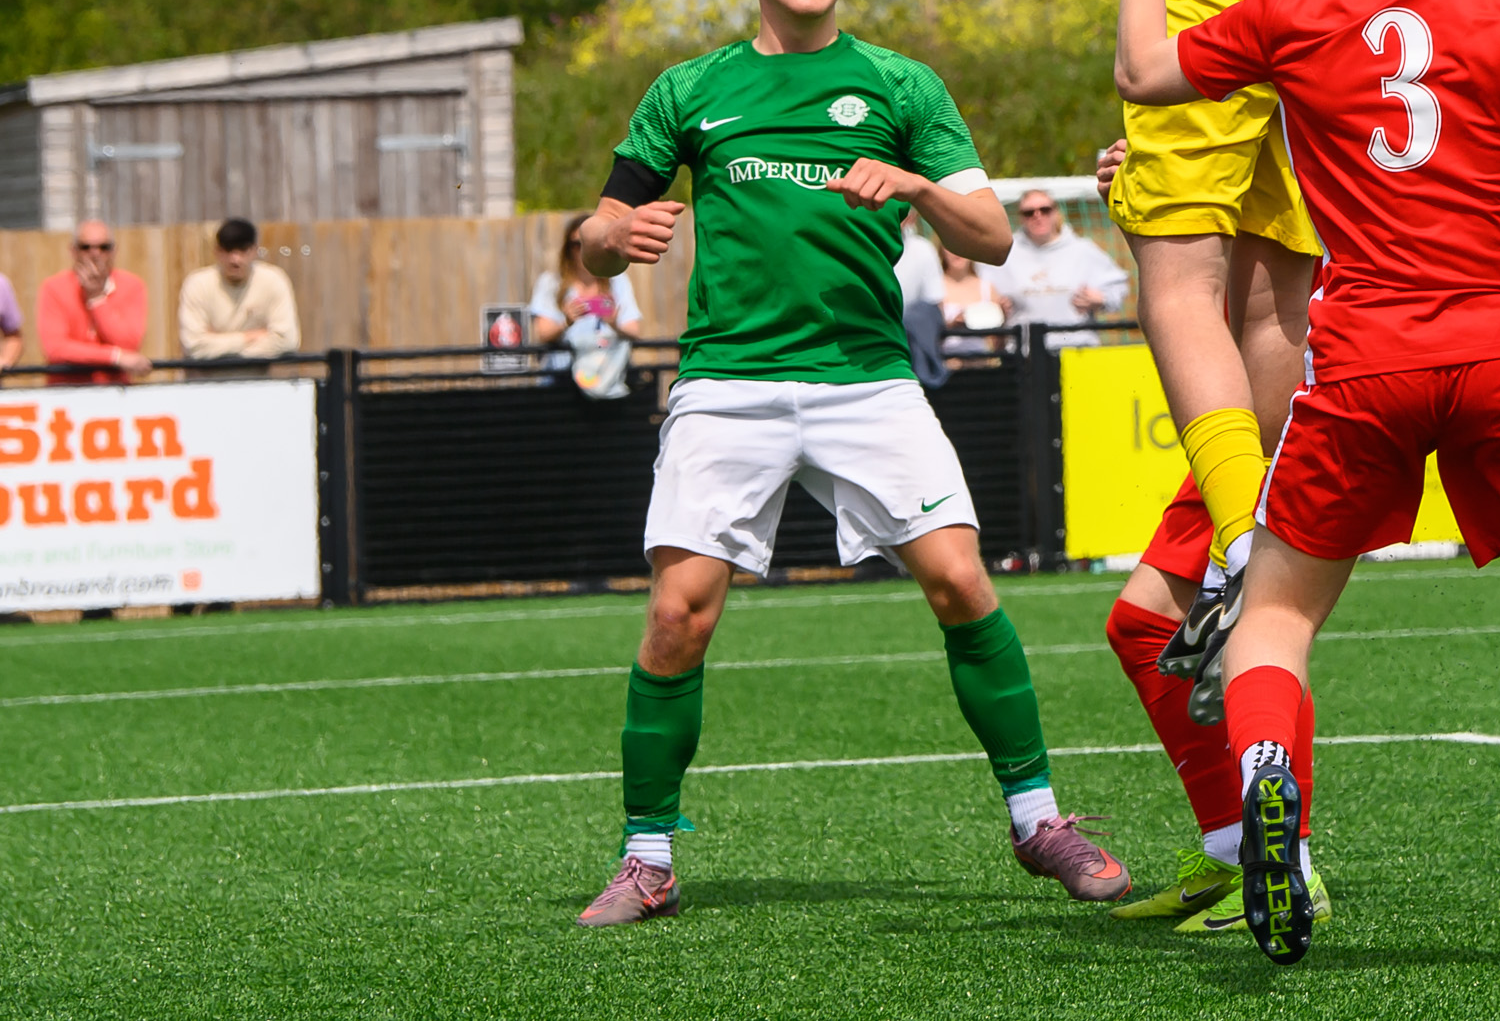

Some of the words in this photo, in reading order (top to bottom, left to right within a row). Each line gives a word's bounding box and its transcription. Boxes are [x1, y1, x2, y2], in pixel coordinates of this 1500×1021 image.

[1361, 7, 1442, 173] 3
[726, 157, 844, 190] IMPERIUM
[0, 403, 184, 466] Stan
[1259, 777, 1292, 955] PREDATOR
